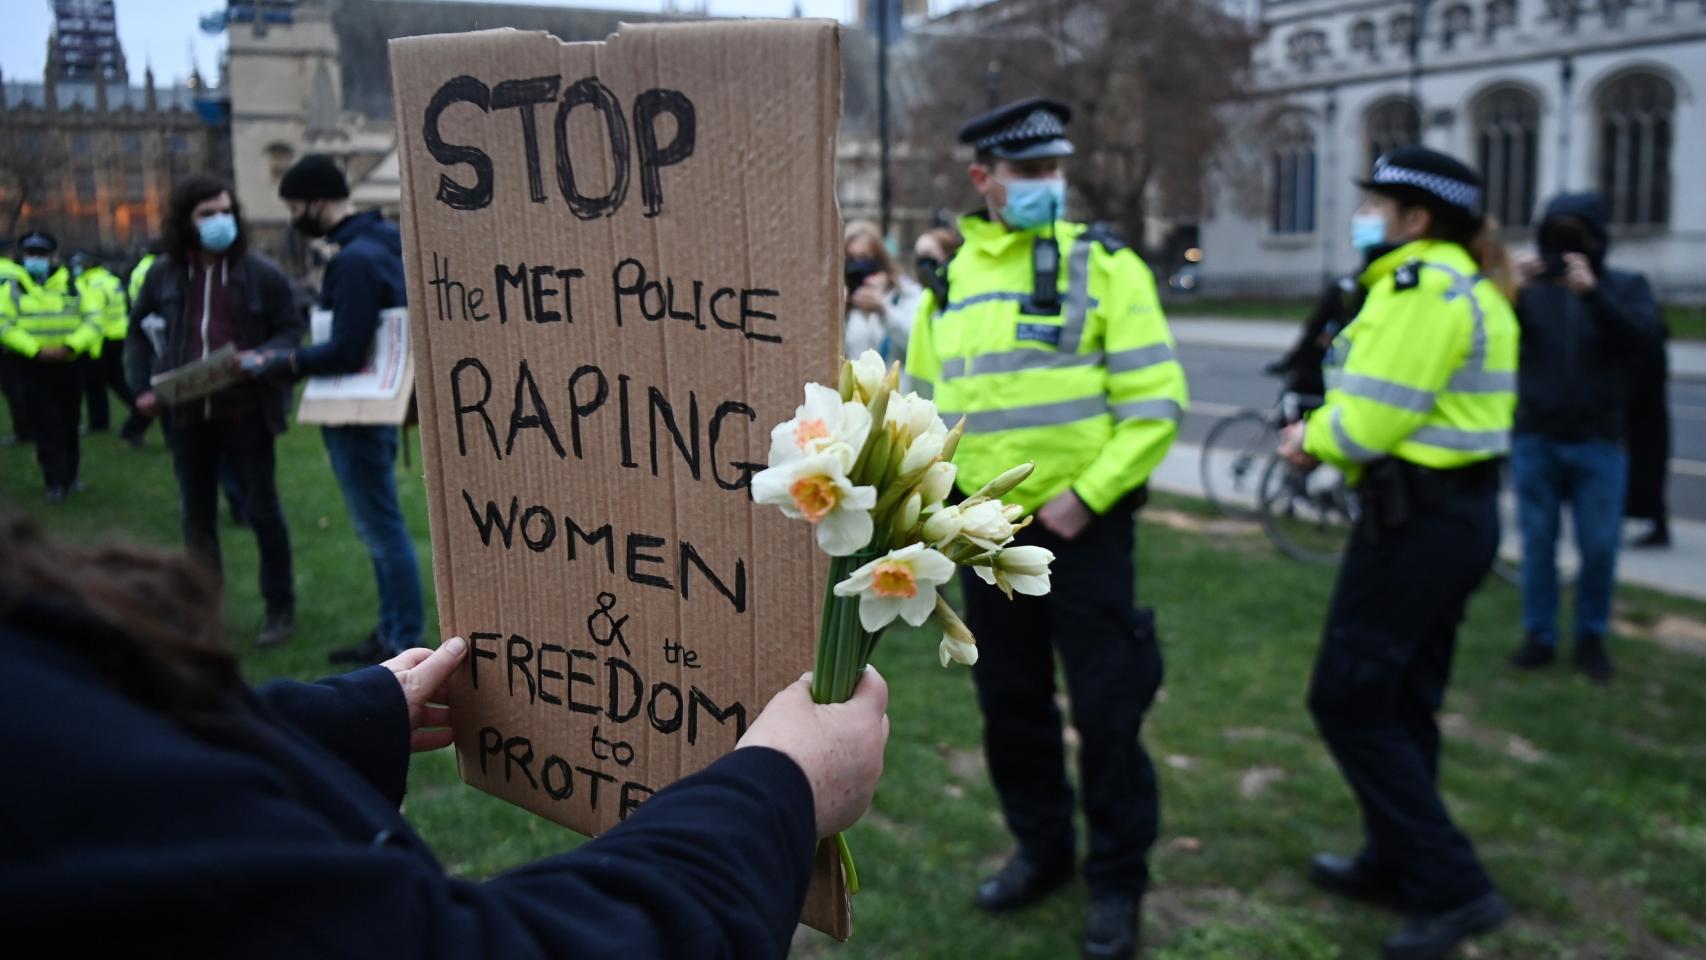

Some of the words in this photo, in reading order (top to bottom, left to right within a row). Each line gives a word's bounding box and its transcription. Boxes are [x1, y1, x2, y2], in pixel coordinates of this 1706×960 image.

[422, 74, 696, 221] STOP
[428, 252, 490, 322] the
[495, 262, 584, 324] MET
[612, 258, 782, 343] POLICE
[450, 357, 768, 499] RAPING
[462, 489, 746, 613] WOMEN
[587, 591, 631, 657] &
[663, 638, 701, 669] the
[470, 632, 747, 745] FREEDOM
[478, 728, 656, 821] PROTE
[591, 725, 634, 766] to
